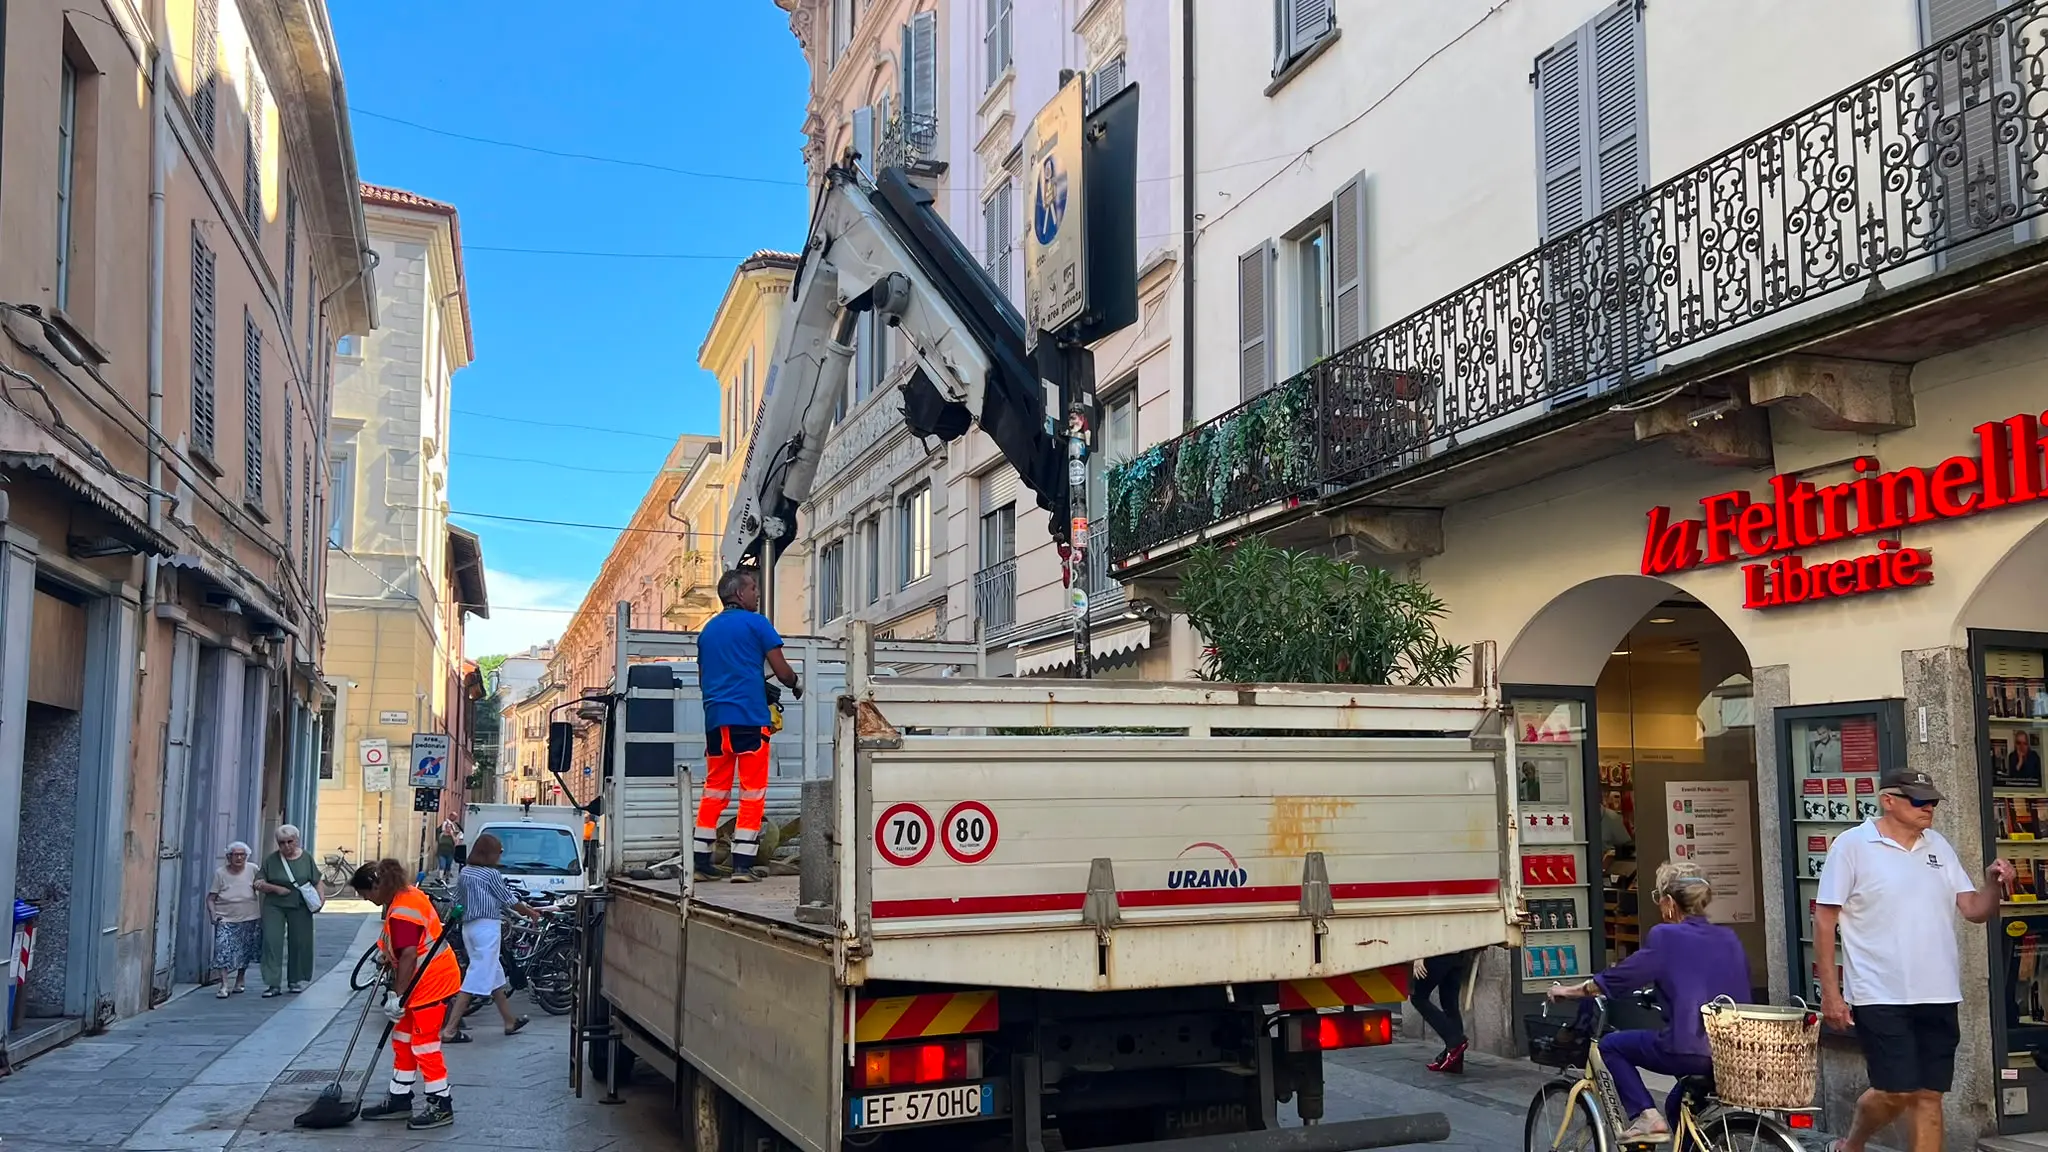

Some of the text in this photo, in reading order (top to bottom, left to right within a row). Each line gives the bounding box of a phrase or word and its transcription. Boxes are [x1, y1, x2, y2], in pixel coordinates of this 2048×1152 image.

[1047, 307, 1060, 323] area
[1061, 290, 1081, 315] privata
[1741, 539, 1934, 611] Librerie
[892, 820, 921, 846] 70
[955, 817, 985, 843] 80
[1167, 867, 1248, 889] URANO
[866, 1096, 896, 1126] EF
[906, 1087, 979, 1121] 570HC
